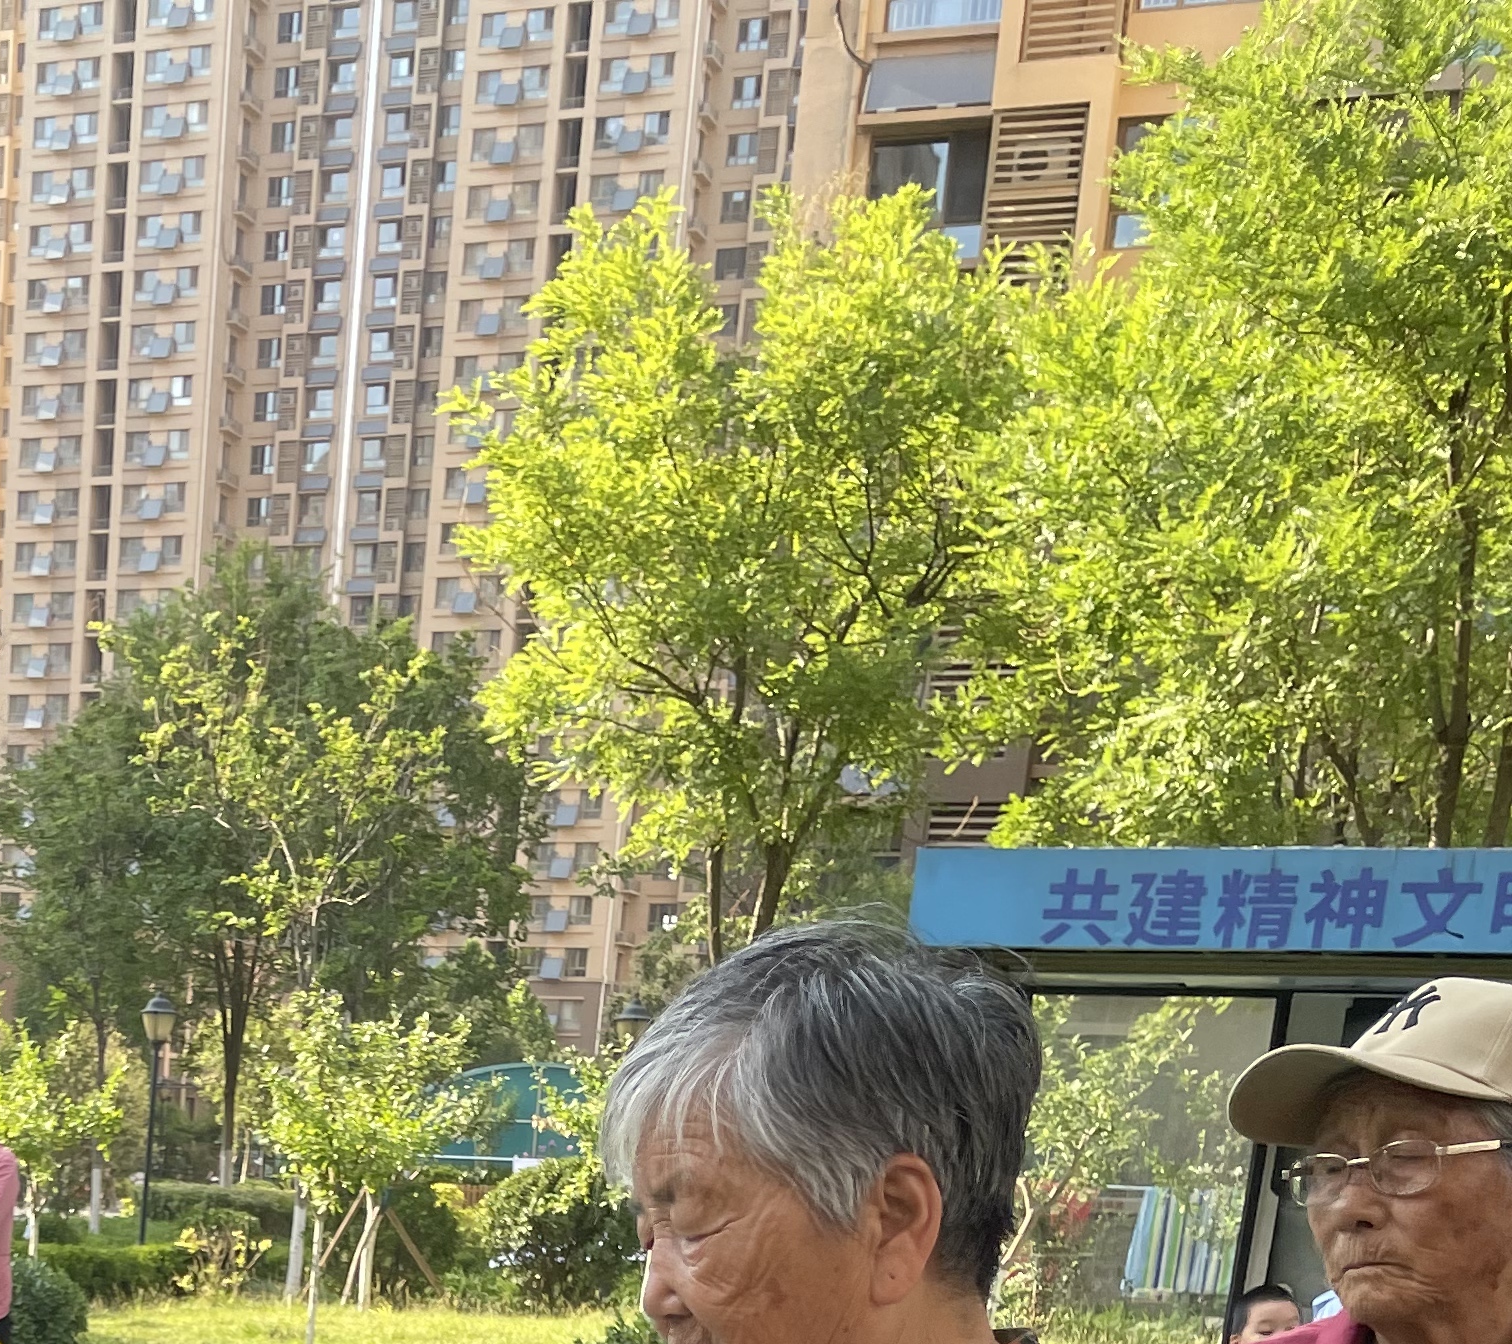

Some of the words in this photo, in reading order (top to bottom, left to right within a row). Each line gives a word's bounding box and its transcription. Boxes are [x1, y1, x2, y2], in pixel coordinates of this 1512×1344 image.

[1040, 866, 1512, 951] 共建精神文
